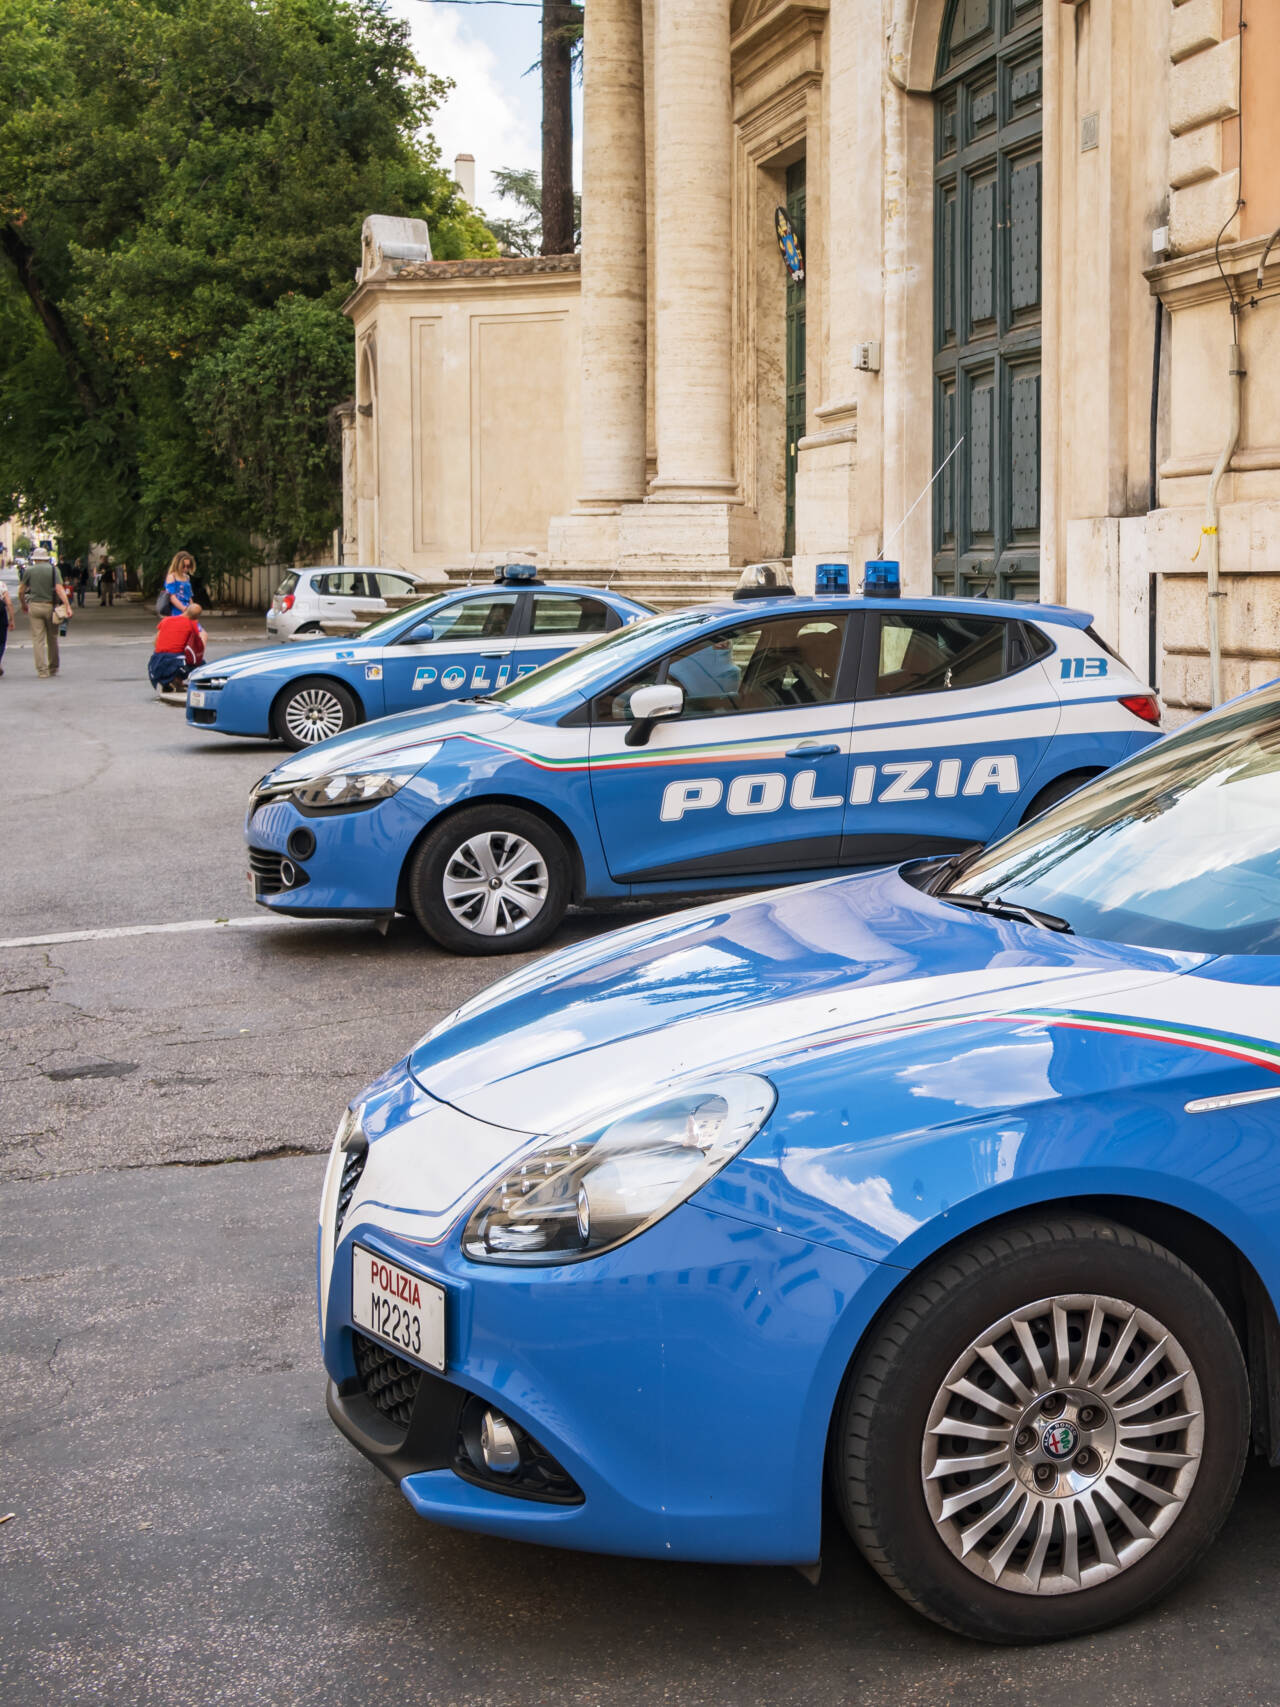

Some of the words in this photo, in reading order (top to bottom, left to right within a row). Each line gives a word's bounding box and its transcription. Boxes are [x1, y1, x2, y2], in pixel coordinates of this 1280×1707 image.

[1060, 657, 1108, 679] 113
[659, 755, 1020, 822] POLIZIA
[371, 1260, 421, 1309] POLIZIA
[371, 1292, 421, 1354] M2233
